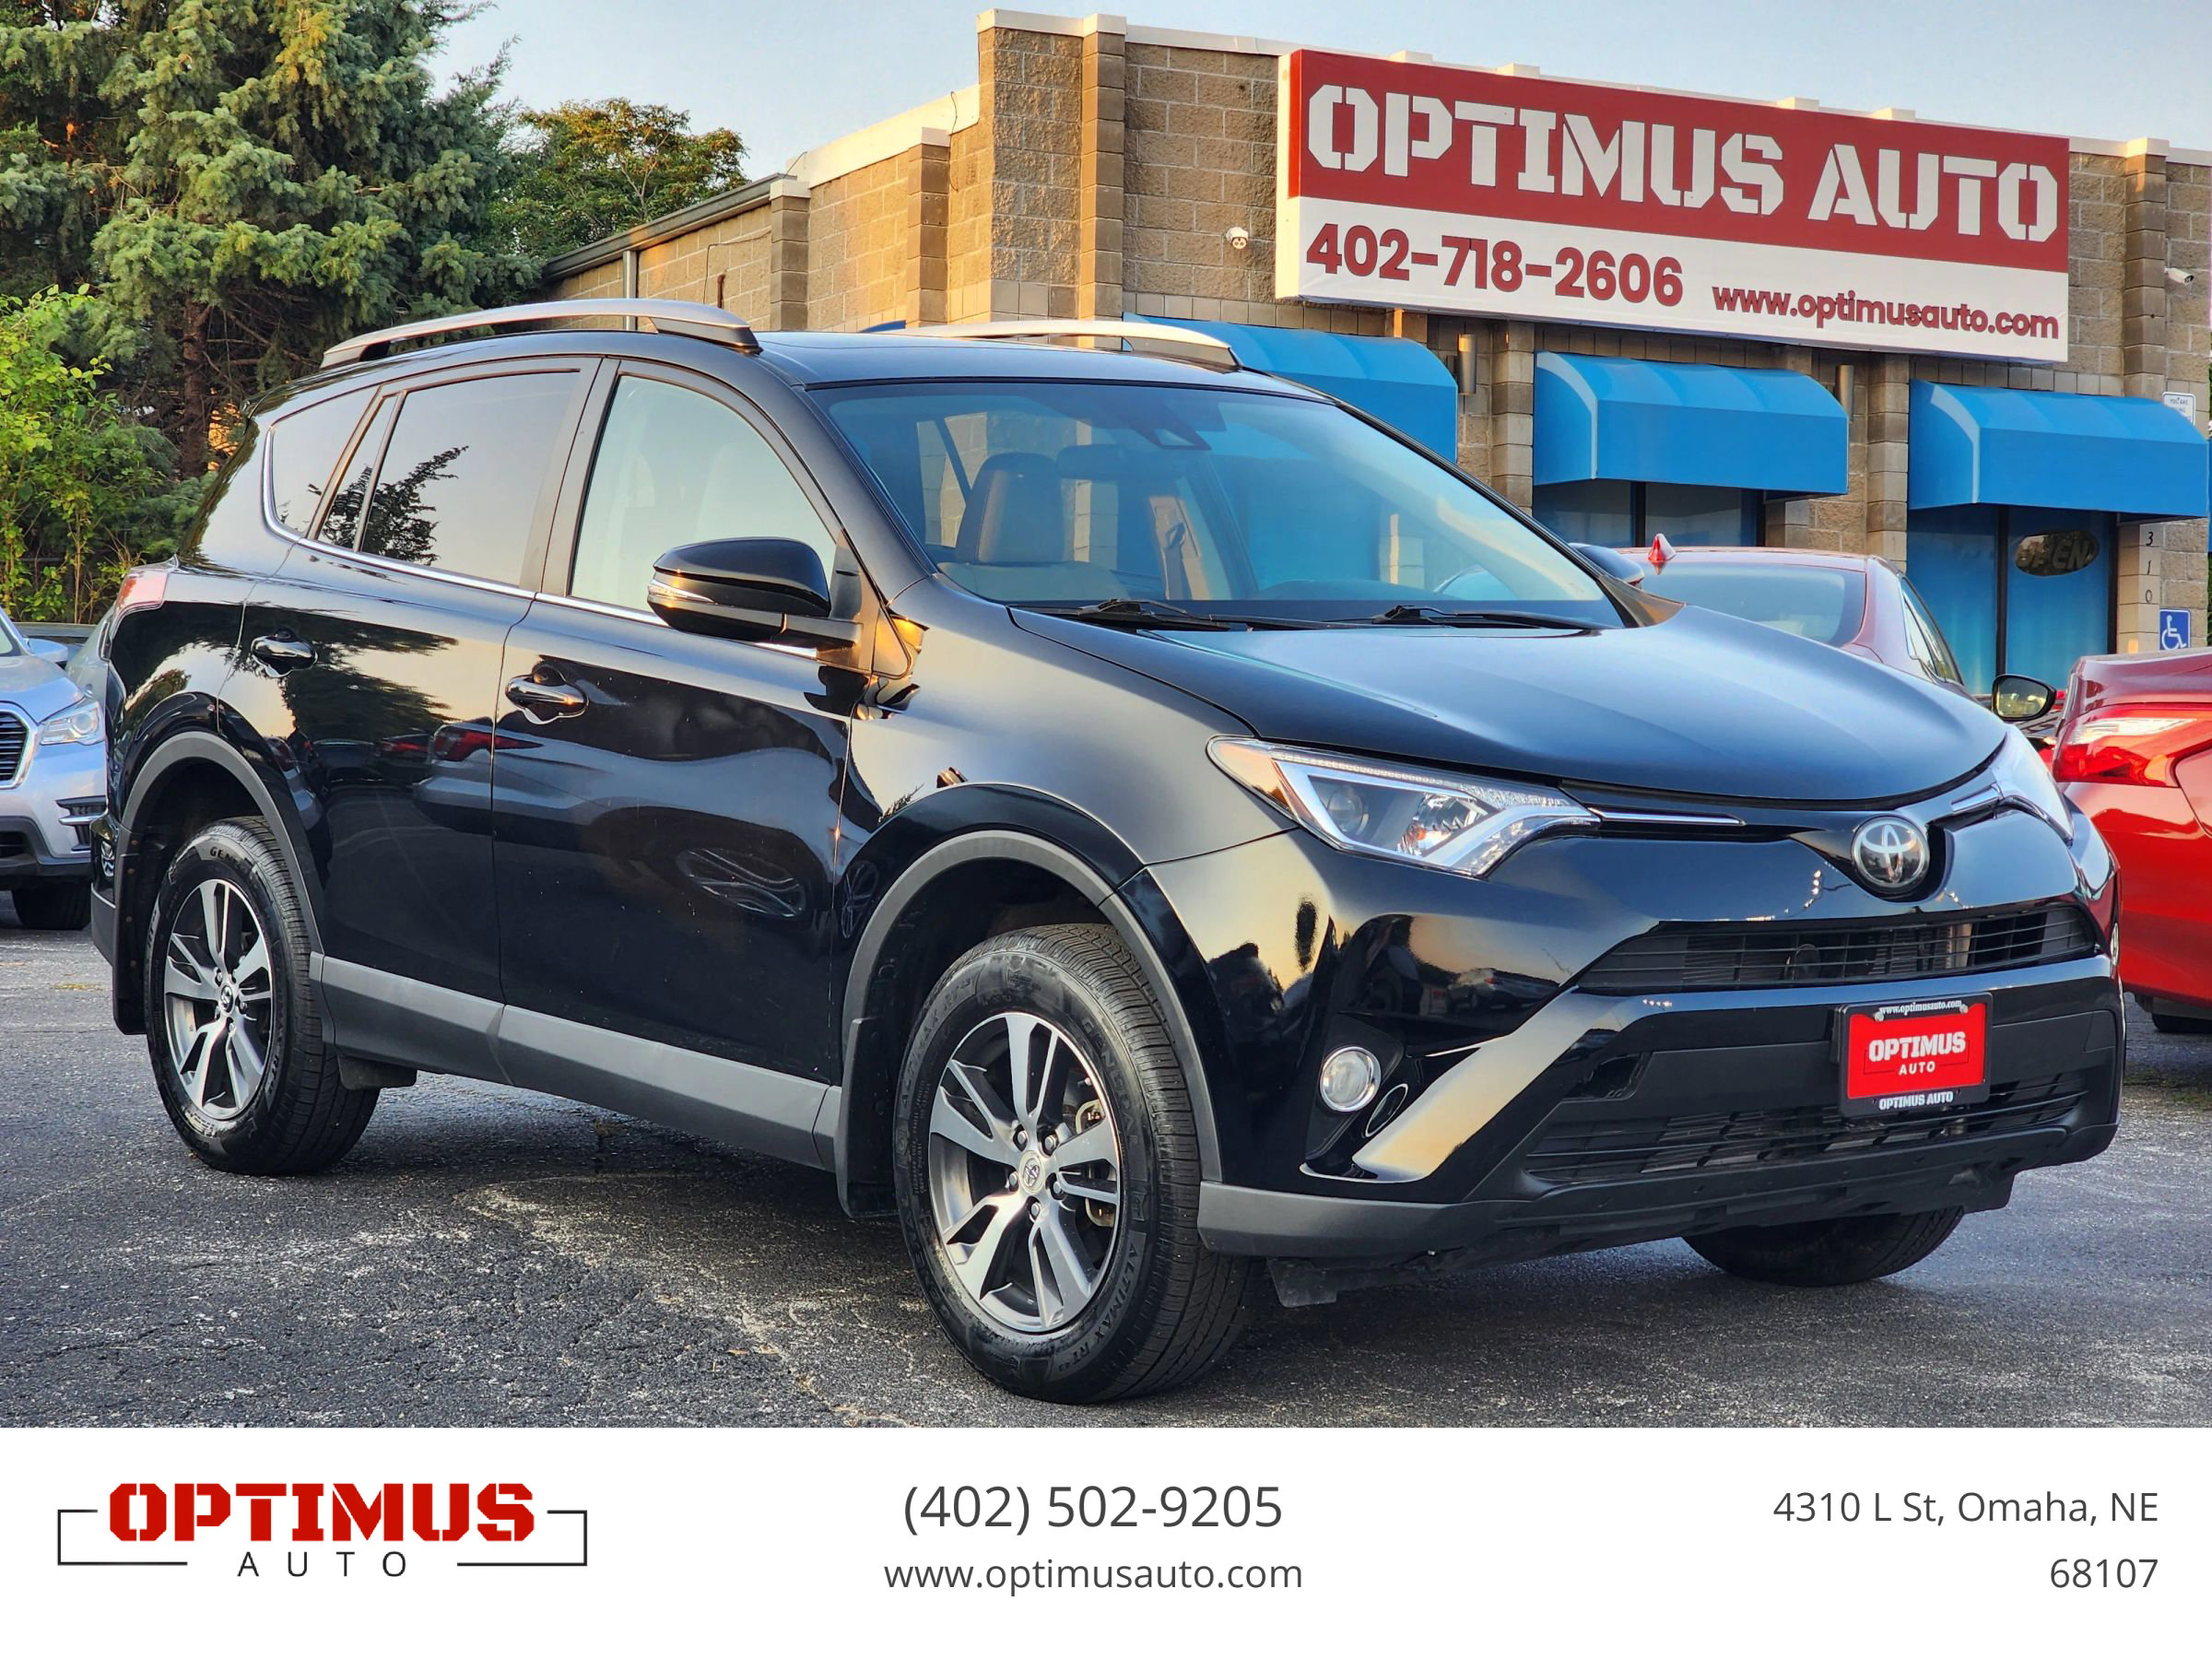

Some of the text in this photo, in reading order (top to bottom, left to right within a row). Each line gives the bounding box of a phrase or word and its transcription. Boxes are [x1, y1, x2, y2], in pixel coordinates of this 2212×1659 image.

[1308, 84, 2058, 243] OPTIMUS AUTO
[1306, 223, 1684, 307] 402-718-2606
[1712, 286, 2059, 340] www.optimusauto.com
[1879, 1000, 1962, 1016] www.optimusauto.com
[1868, 1031, 1966, 1062] OPTIMUS
[1899, 1061, 1936, 1077] AUTO
[1878, 1090, 1954, 1111] OPTIMUS AUTO
